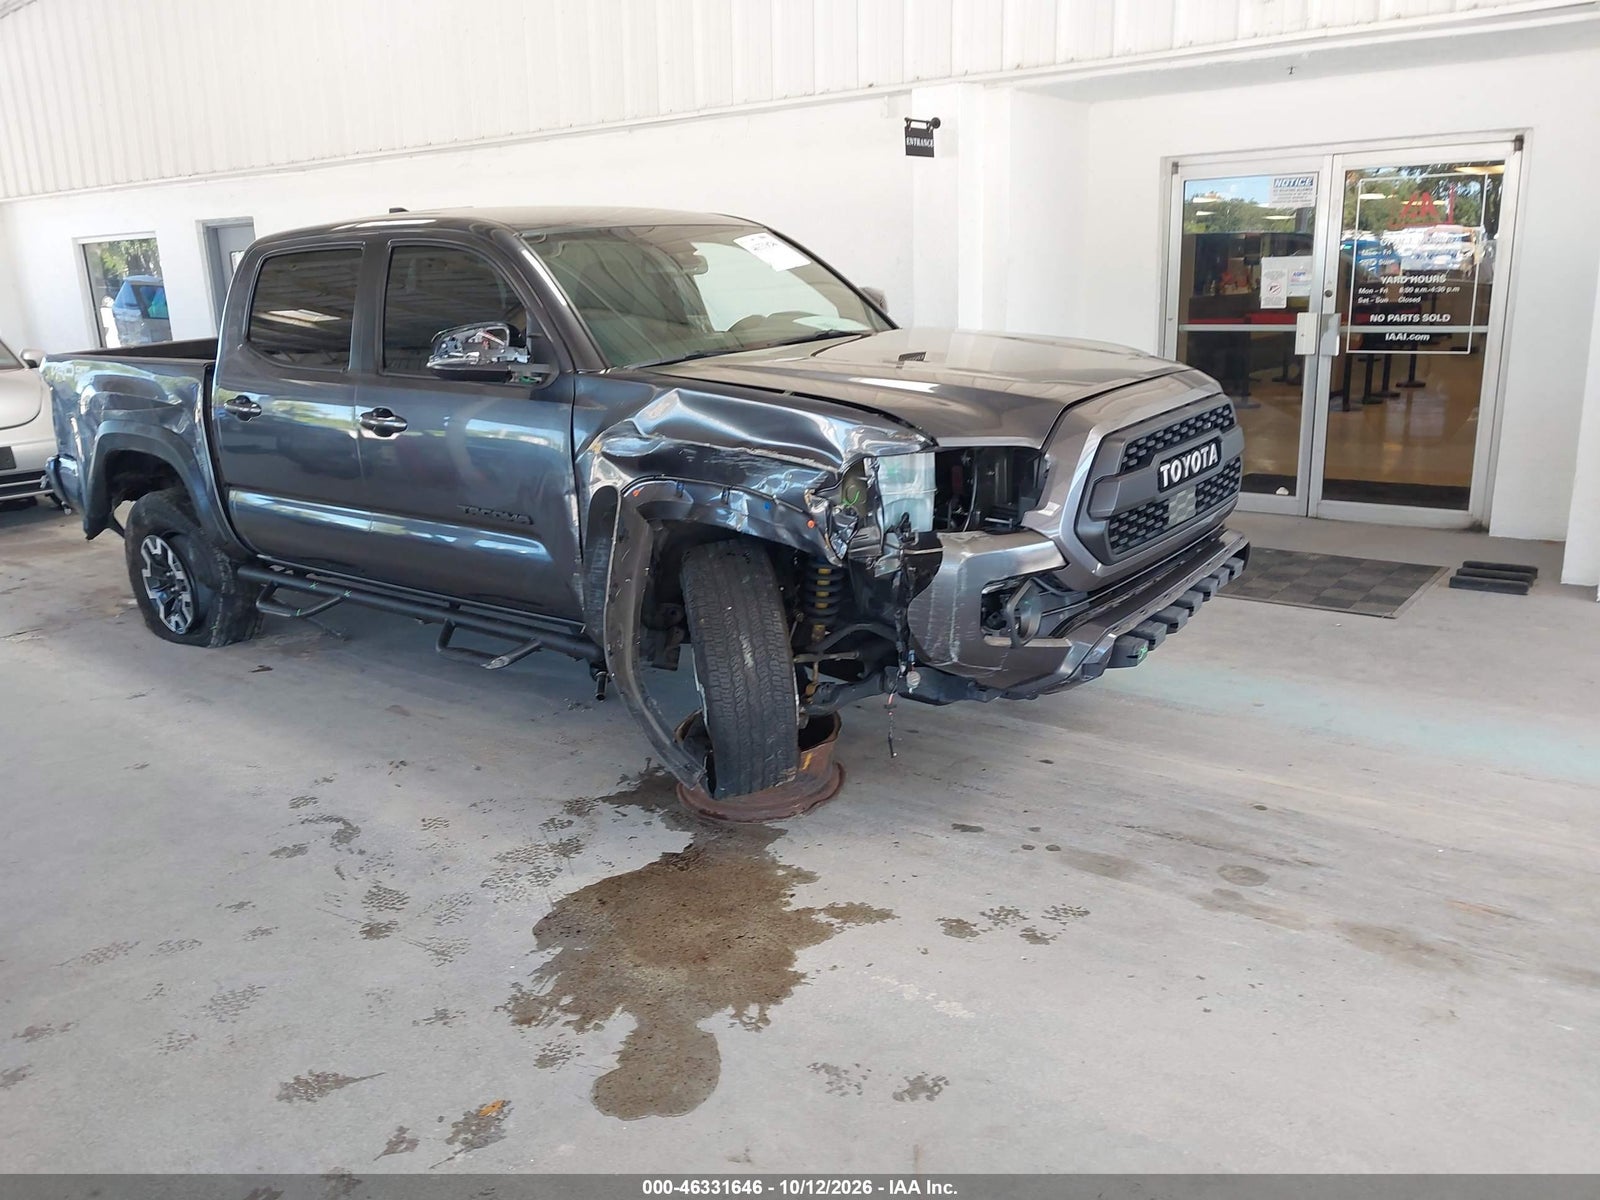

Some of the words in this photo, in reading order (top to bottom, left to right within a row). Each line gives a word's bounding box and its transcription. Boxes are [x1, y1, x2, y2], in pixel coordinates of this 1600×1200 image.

[906, 137, 934, 147] ENTRANCE
[1274, 177, 1313, 187] NOTICE
[1380, 275, 1408, 284] YARD
[1410, 274, 1447, 284] HOURS
[1375, 296, 1389, 304] Sun
[1369, 313, 1385, 322] NO
[1387, 313, 1421, 322] PARTS
[1422, 313, 1451, 322] SOLD
[1385, 333, 1431, 341] IAAI.com
[1160, 443, 1218, 488] TOYOTA
